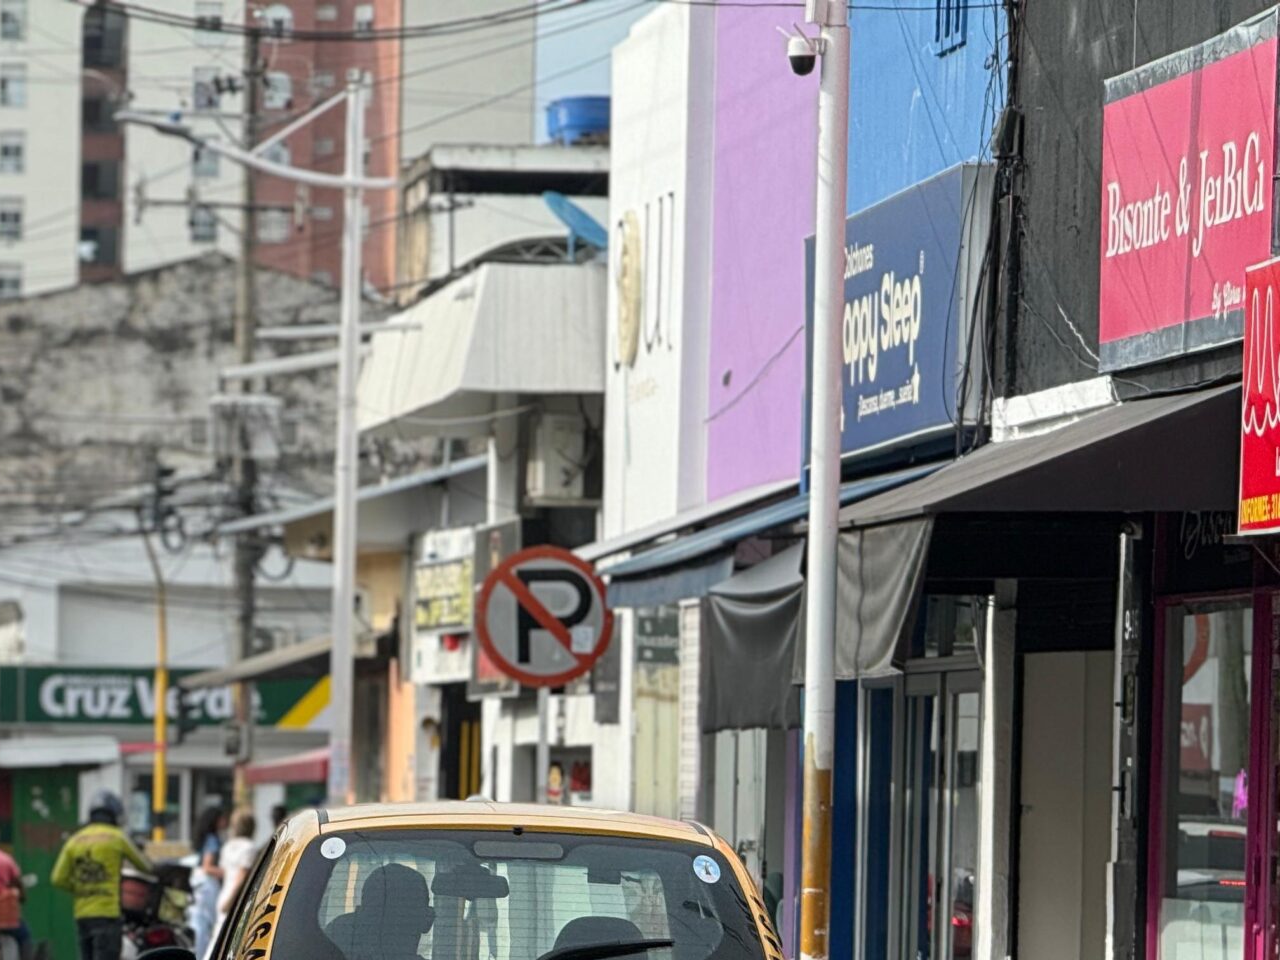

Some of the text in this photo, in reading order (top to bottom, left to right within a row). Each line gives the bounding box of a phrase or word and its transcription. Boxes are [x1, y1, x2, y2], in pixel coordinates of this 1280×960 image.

[1176, 156, 1191, 237] &
[881, 270, 921, 367] Sleep
[40, 675, 132, 718] Cruz
